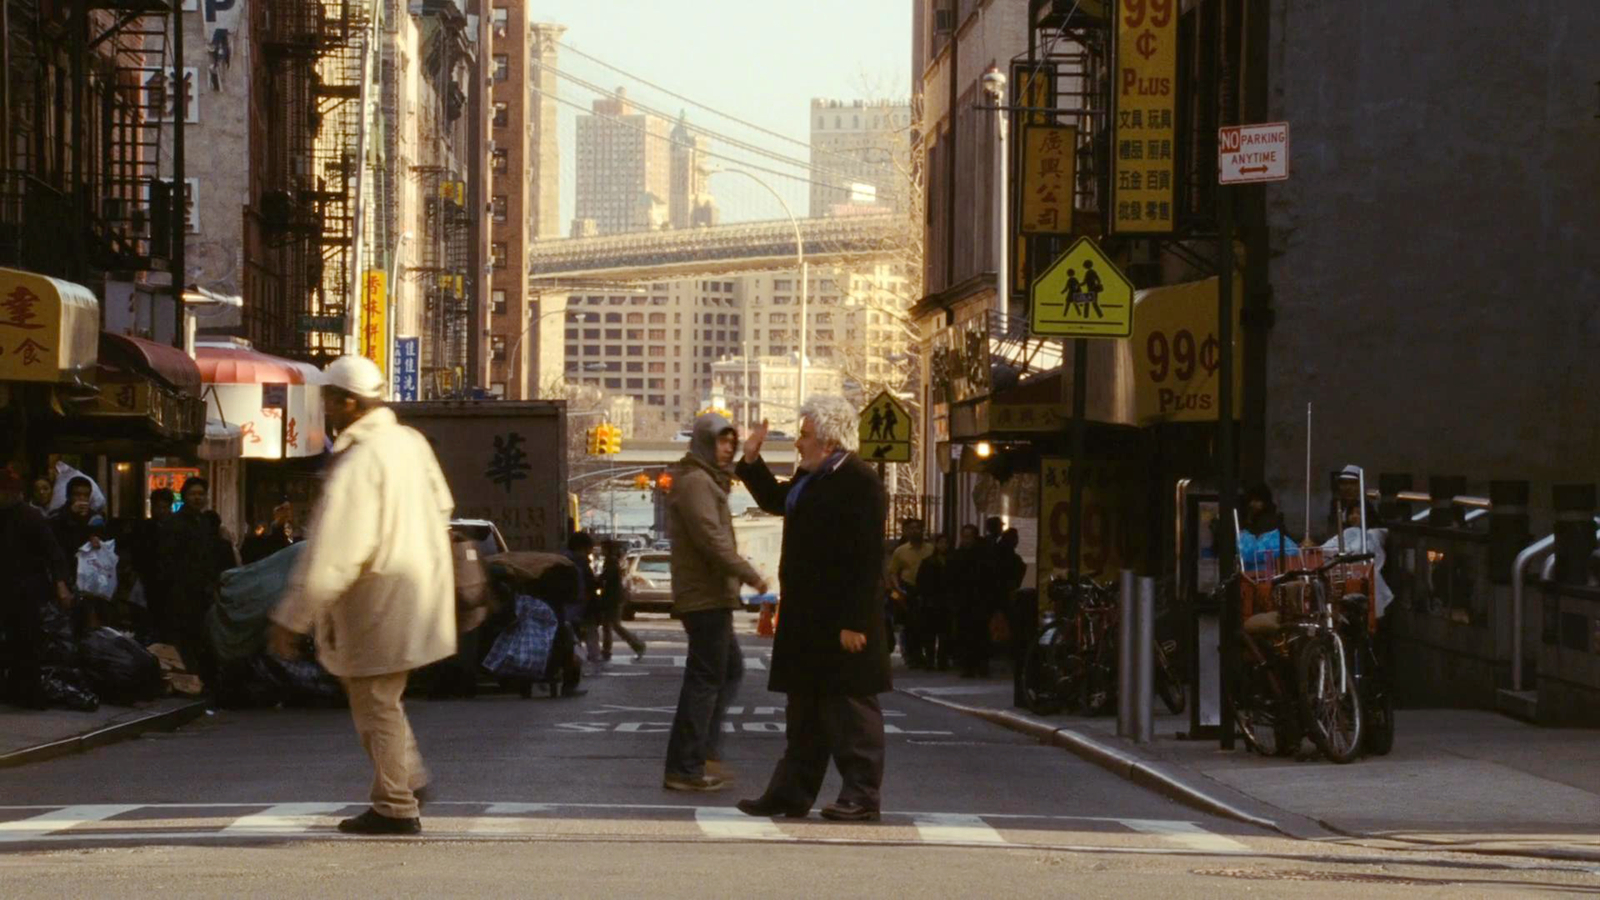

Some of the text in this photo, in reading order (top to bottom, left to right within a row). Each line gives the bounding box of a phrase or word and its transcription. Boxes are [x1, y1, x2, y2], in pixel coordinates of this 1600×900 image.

[1119, 109, 1171, 129] 文具 玩具
[1221, 132, 1285, 150] NO PARKING
[1232, 152, 1277, 165] ANYTIME
[1119, 170, 1142, 190] 五金
[1147, 330, 1221, 383] 99¢
[394, 341, 402, 401] LAUNDR
